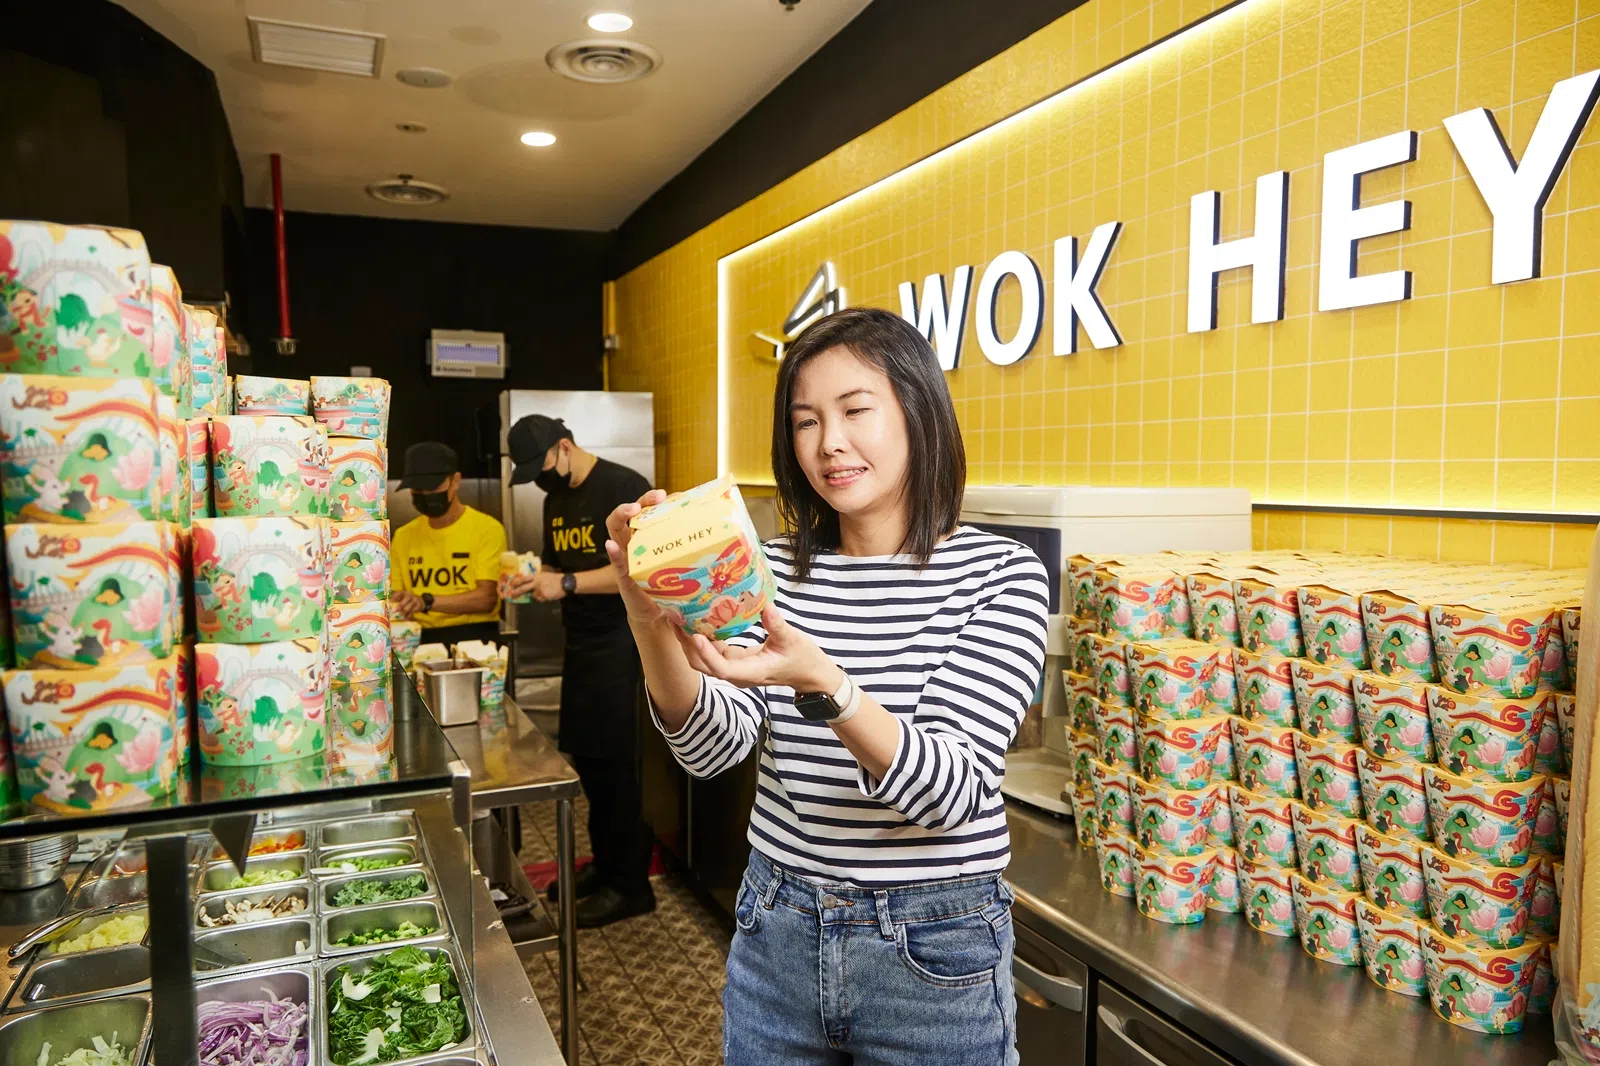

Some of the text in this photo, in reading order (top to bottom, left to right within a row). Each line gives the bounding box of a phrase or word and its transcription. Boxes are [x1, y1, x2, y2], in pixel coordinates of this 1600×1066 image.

[898, 69, 1600, 371] WOK HEY
[552, 524, 596, 552] WOK
[652, 526, 713, 556] WOK HEY
[409, 565, 468, 588] WOK
